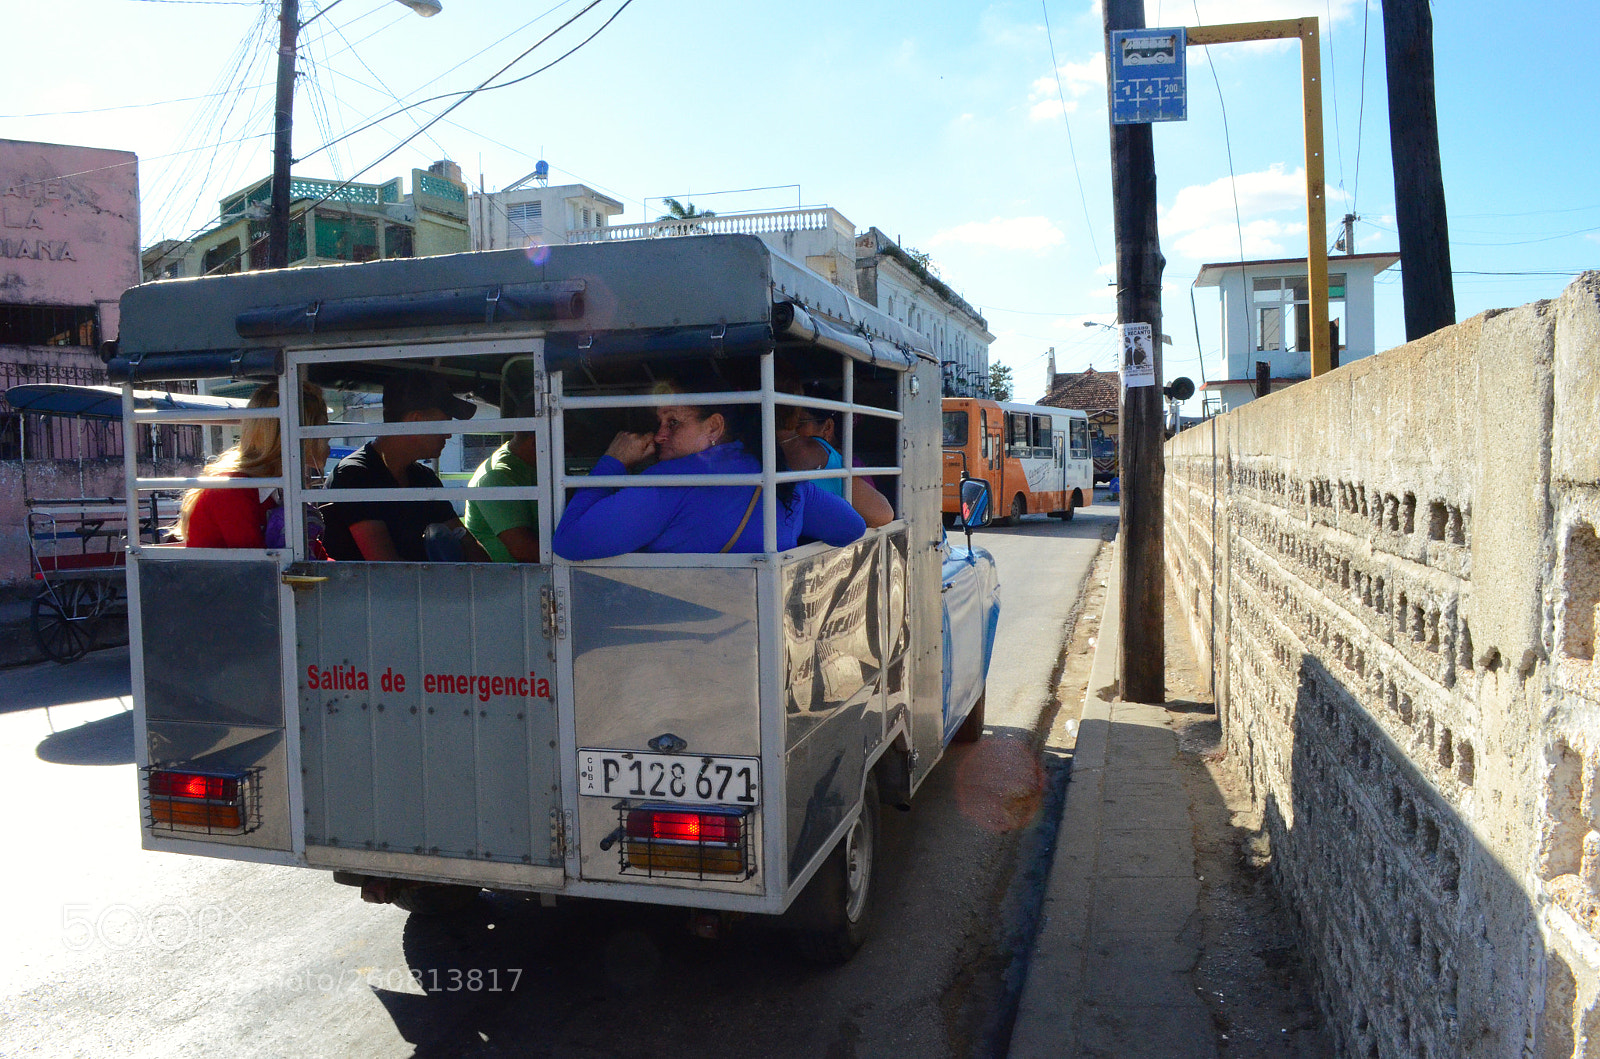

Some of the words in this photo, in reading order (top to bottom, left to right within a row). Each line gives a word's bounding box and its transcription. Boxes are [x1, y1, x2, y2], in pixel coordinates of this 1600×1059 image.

[1122, 85, 1131, 95] 1
[1144, 85, 1154, 95] 4
[1164, 84, 1178, 94] 200
[2, 207, 43, 231] LA
[0, 238, 77, 262] IANA
[307, 664, 369, 691] Salida
[380, 667, 406, 693] de
[424, 671, 551, 702] emergencia
